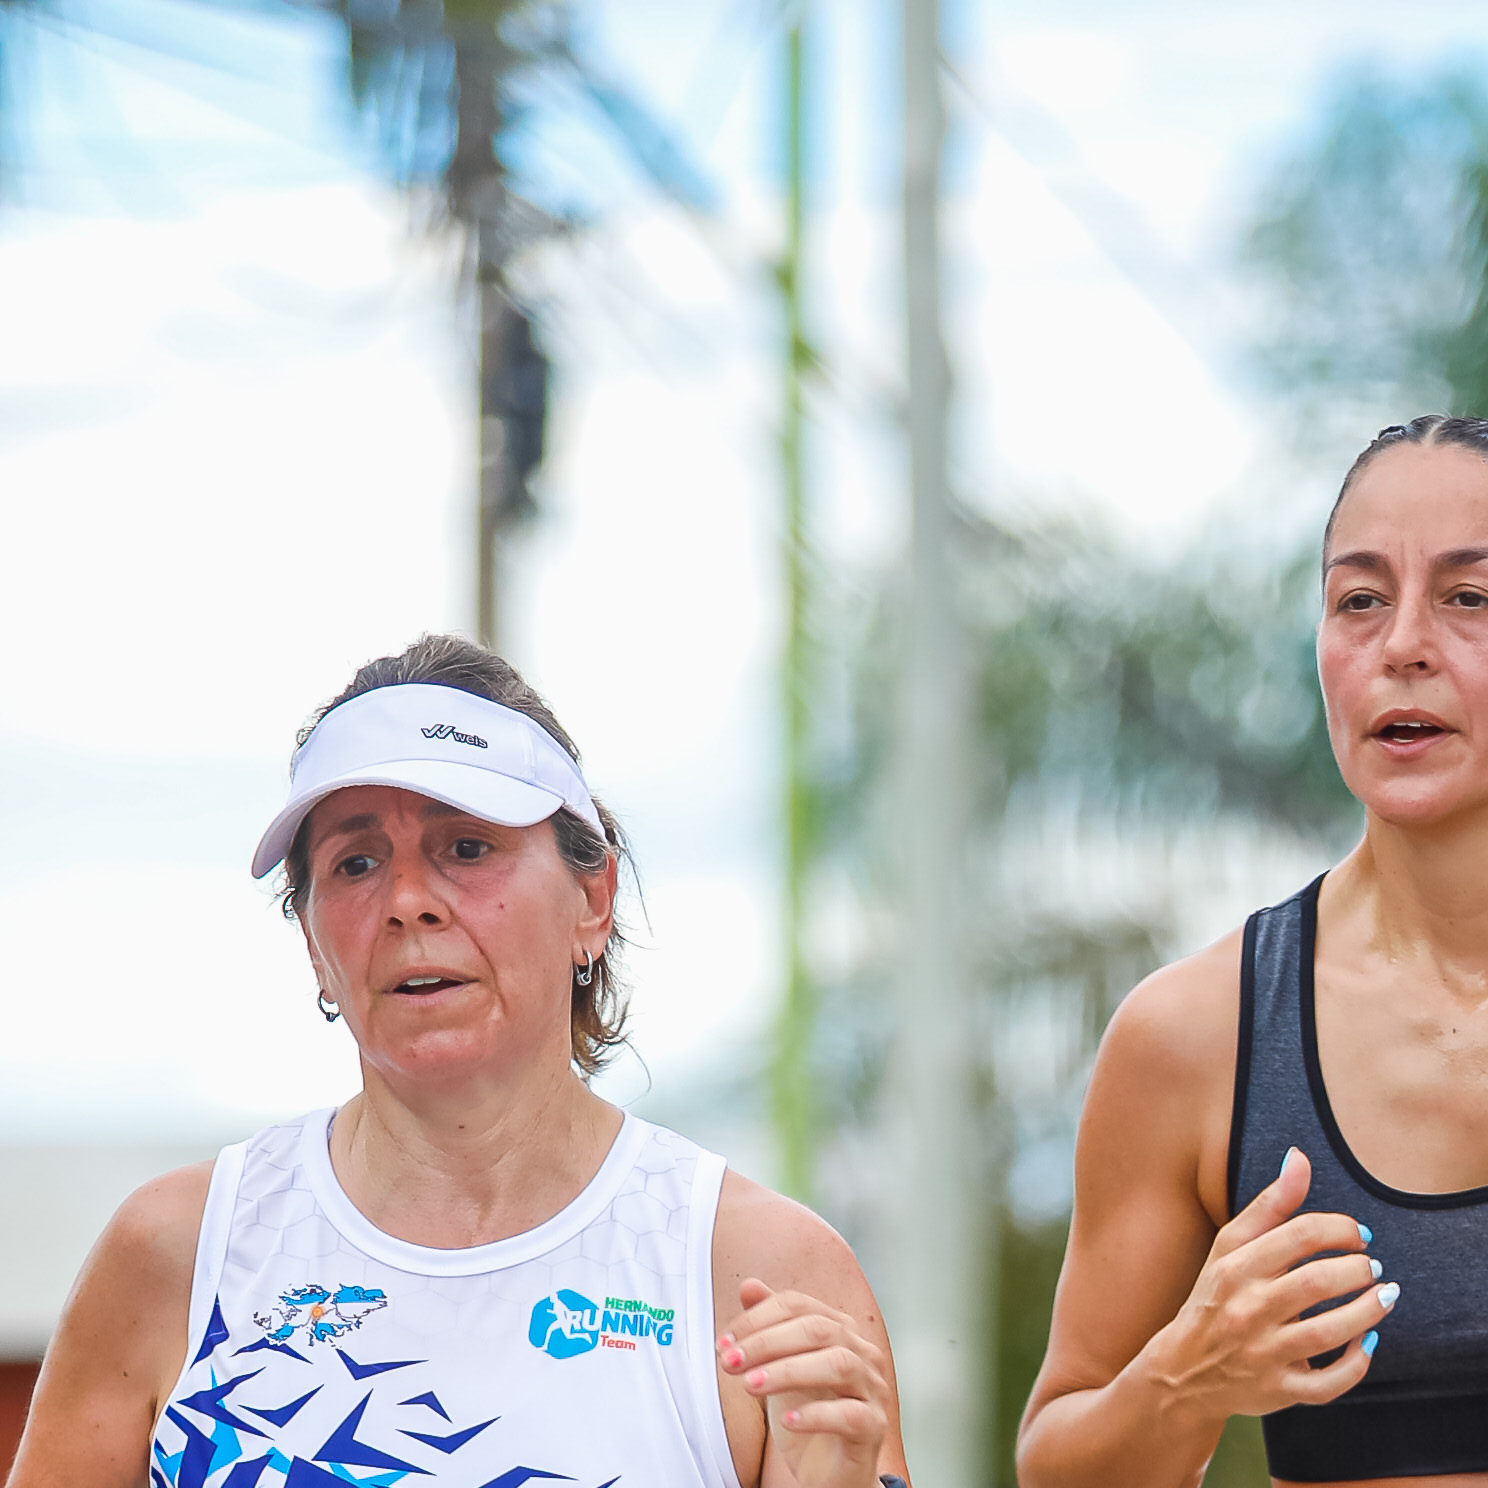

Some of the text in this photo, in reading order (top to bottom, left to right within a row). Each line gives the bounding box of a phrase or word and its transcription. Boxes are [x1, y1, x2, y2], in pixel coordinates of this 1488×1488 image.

[453, 732, 488, 748] weis
[604, 1296, 675, 1322] HERNANDO
[570, 1309, 674, 1346] RUNNING
[600, 1335, 636, 1351] Team
